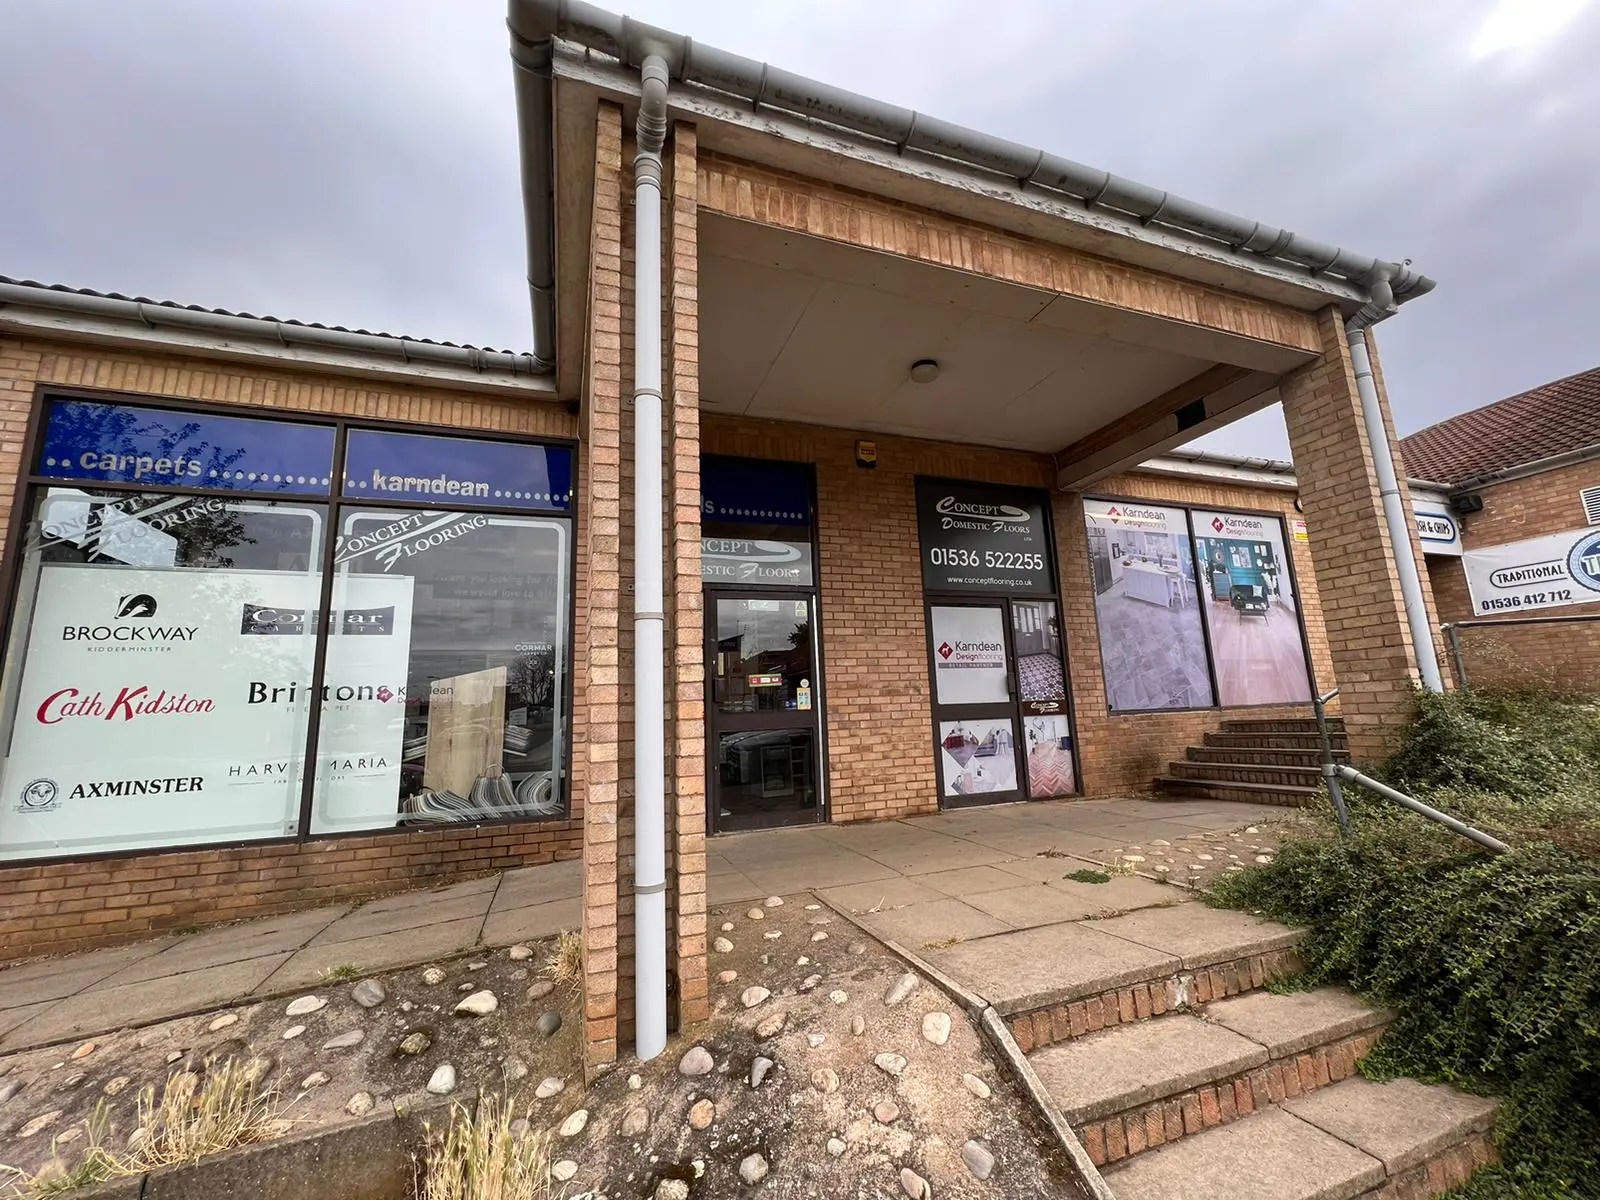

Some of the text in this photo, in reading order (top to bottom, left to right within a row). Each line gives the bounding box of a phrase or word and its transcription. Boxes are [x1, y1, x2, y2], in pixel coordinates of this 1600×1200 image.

[80, 451, 202, 478] carpets
[372, 469, 489, 498] karndean
[936, 496, 999, 515] CONCEPT
[1122, 506, 1166, 520] Karndean
[88, 498, 223, 562] FLOORING
[941, 517, 1030, 533] DOMESTIC FLOORS
[1224, 516, 1262, 529] Karndean
[1427, 521, 1434, 532] &
[1434, 522, 1450, 534] CHIPS
[375, 514, 488, 572] FLOORING
[930, 547, 1043, 570] 01536 522255
[947, 576, 1032, 586] www.conceptflooring.co.uk
[1497, 564, 1564, 584] TRADITIONAL
[1481, 589, 1572, 611] 01536 412 712
[252, 609, 383, 624] Corar
[62, 626, 199, 641] BROCKWAY
[513, 644, 553, 652] CORMAR
[955, 641, 1002, 652] Karndean
[955, 652, 1003, 661] Designflooring
[37, 685, 215, 724] Cath Kidston
[229, 762, 304, 777] HARV
[69, 776, 204, 800] AXMINSTER
